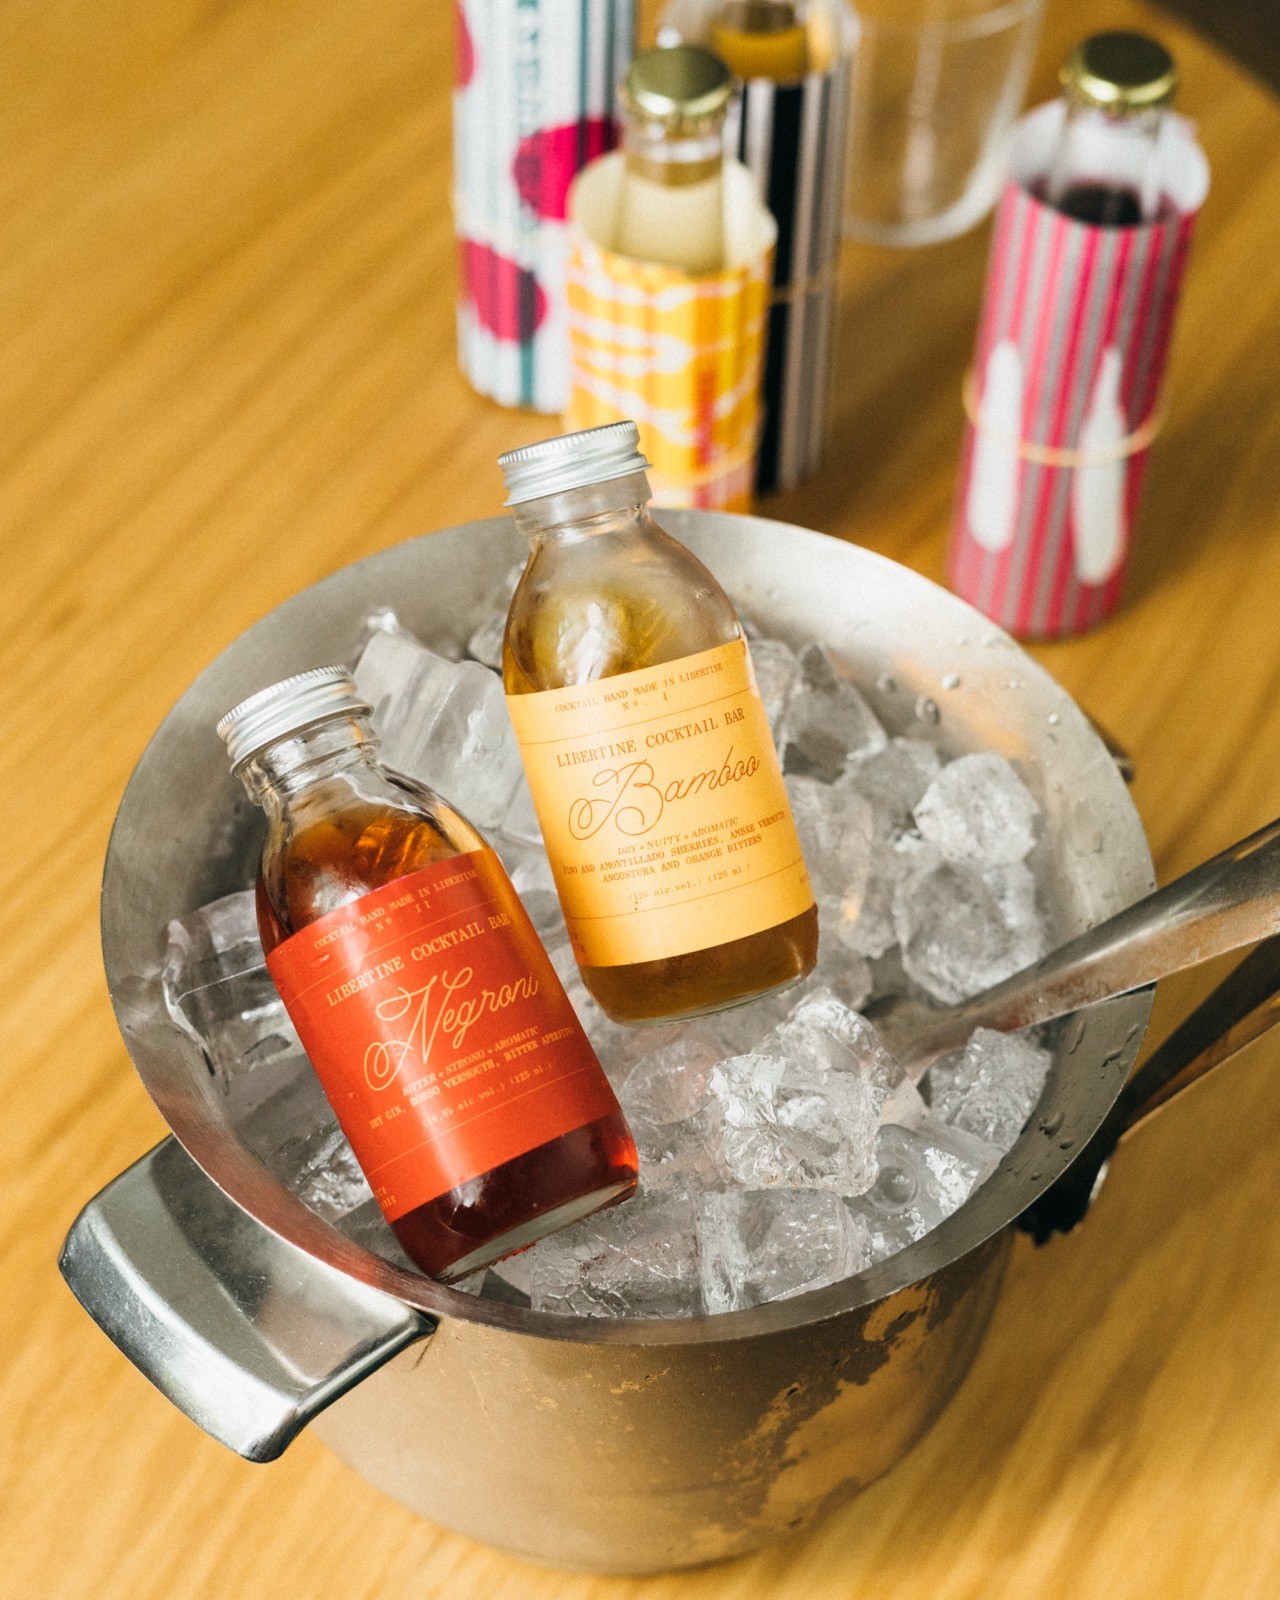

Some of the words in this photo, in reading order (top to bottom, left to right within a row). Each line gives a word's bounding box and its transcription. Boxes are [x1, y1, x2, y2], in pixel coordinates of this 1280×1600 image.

[555, 696, 600, 713] COCKTAIL
[604, 690, 629, 703] HAND
[633, 682, 658, 696] MADE
[664, 676, 676, 688] IN
[680, 662, 724, 683] LIBERTINE
[555, 739, 637, 767] LIBERTINE
[645, 718, 719, 748] COCKTAIL
[724, 707, 746, 725] BAR
[568, 745, 761, 841] Bamboo
[581, 864, 595, 874] AND
[600, 851, 665, 872] AMONTILLADO
[730, 824, 756, 840] AMBRE
[603, 866, 656, 883] ANGOSTURA
[661, 860, 680, 872] AND
[685, 847, 723, 865] ORANGE
[727, 834, 763, 853] BITTERS
[618, 844, 637, 855] DRY
[647, 834, 682, 849] NUTTY
[691, 817, 739, 839] AROMATIC
[314, 924, 357, 950] COCKTAIL
[359, 907, 386, 926] HAND
[388, 894, 415, 912] MADE
[418, 887, 431, 899] IN
[433, 869, 478, 892] LIBERTINE
[326, 956, 405, 1007] LIBERTINE
[411, 922, 485, 961] COCKTAIL
[487, 912, 511, 930] BAR
[364, 967, 539, 1091] Negroni
[445, 1049, 486, 1074] STRONG
[494, 1025, 539, 1052] AROMATIC
[503, 1040, 539, 1062] BITTER
